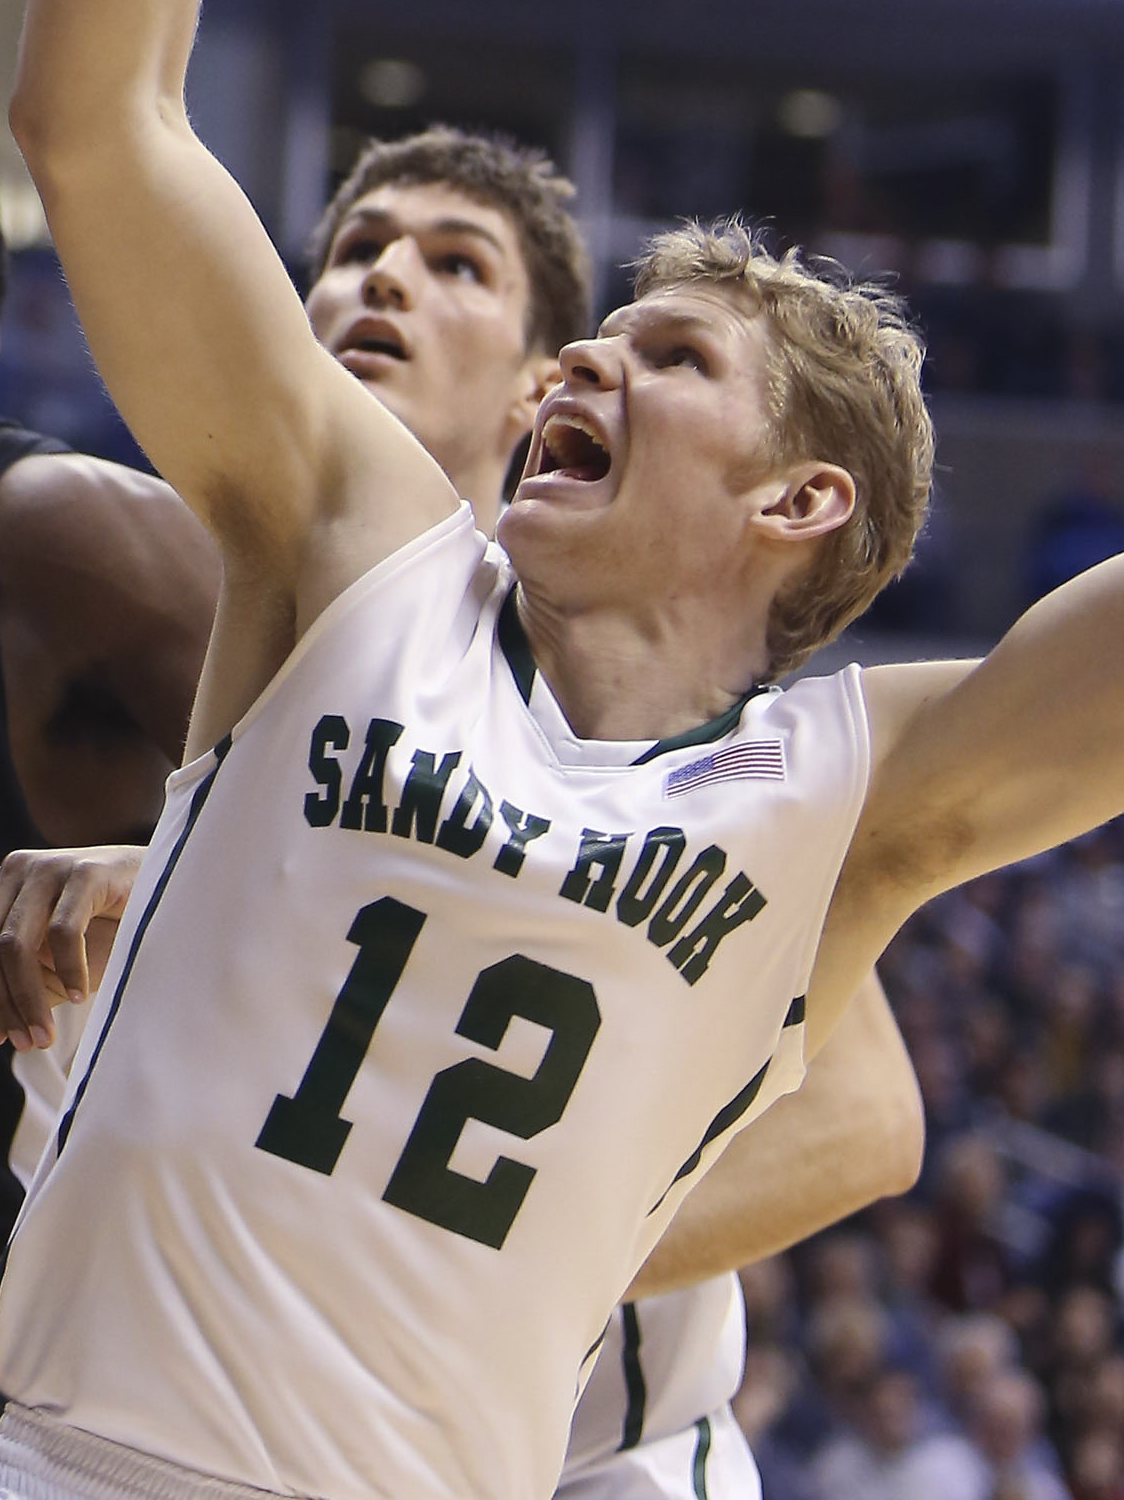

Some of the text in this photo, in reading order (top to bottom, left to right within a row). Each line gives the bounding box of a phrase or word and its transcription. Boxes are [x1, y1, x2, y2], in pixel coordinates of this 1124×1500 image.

[303, 715, 768, 987] SANDY HOOK
[254, 895, 602, 1251] 12
